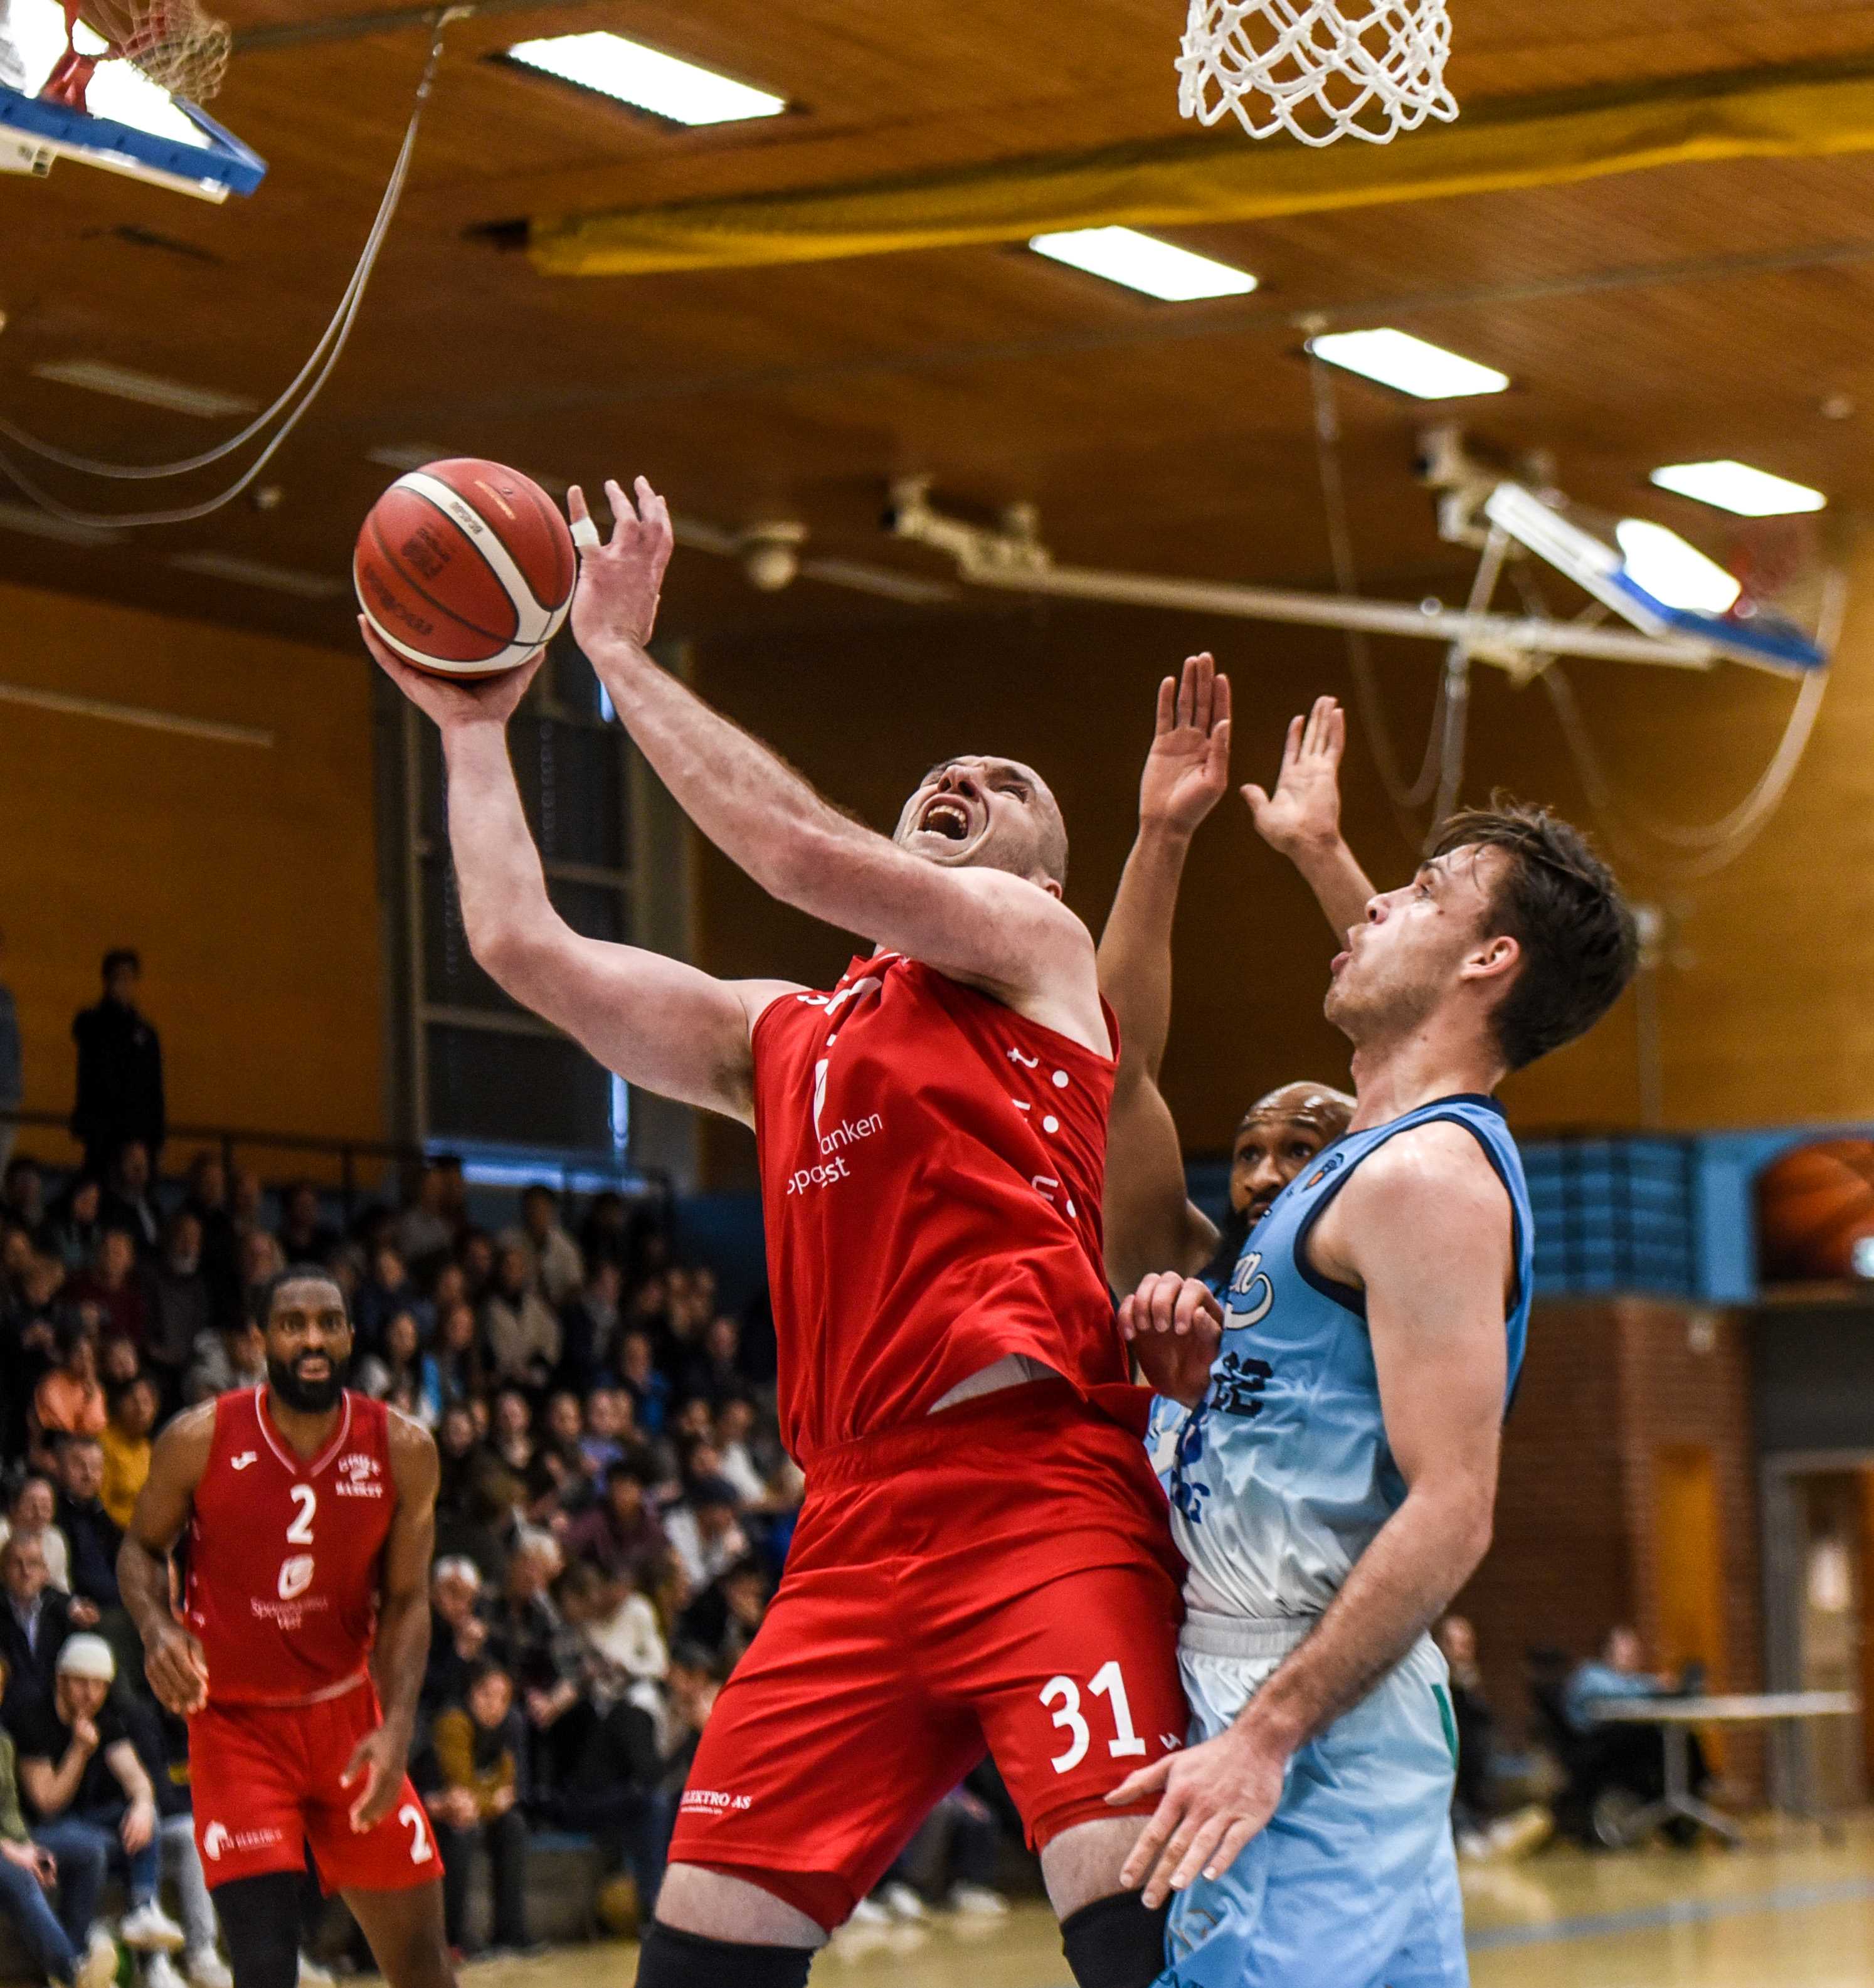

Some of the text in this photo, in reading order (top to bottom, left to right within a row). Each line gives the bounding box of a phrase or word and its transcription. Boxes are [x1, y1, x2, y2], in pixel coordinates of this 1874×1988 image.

[286, 1484, 316, 1545] 2
[1039, 1661, 1146, 1774] 31
[731, 1795, 752, 1809] AS
[398, 1804, 433, 1864] 2
